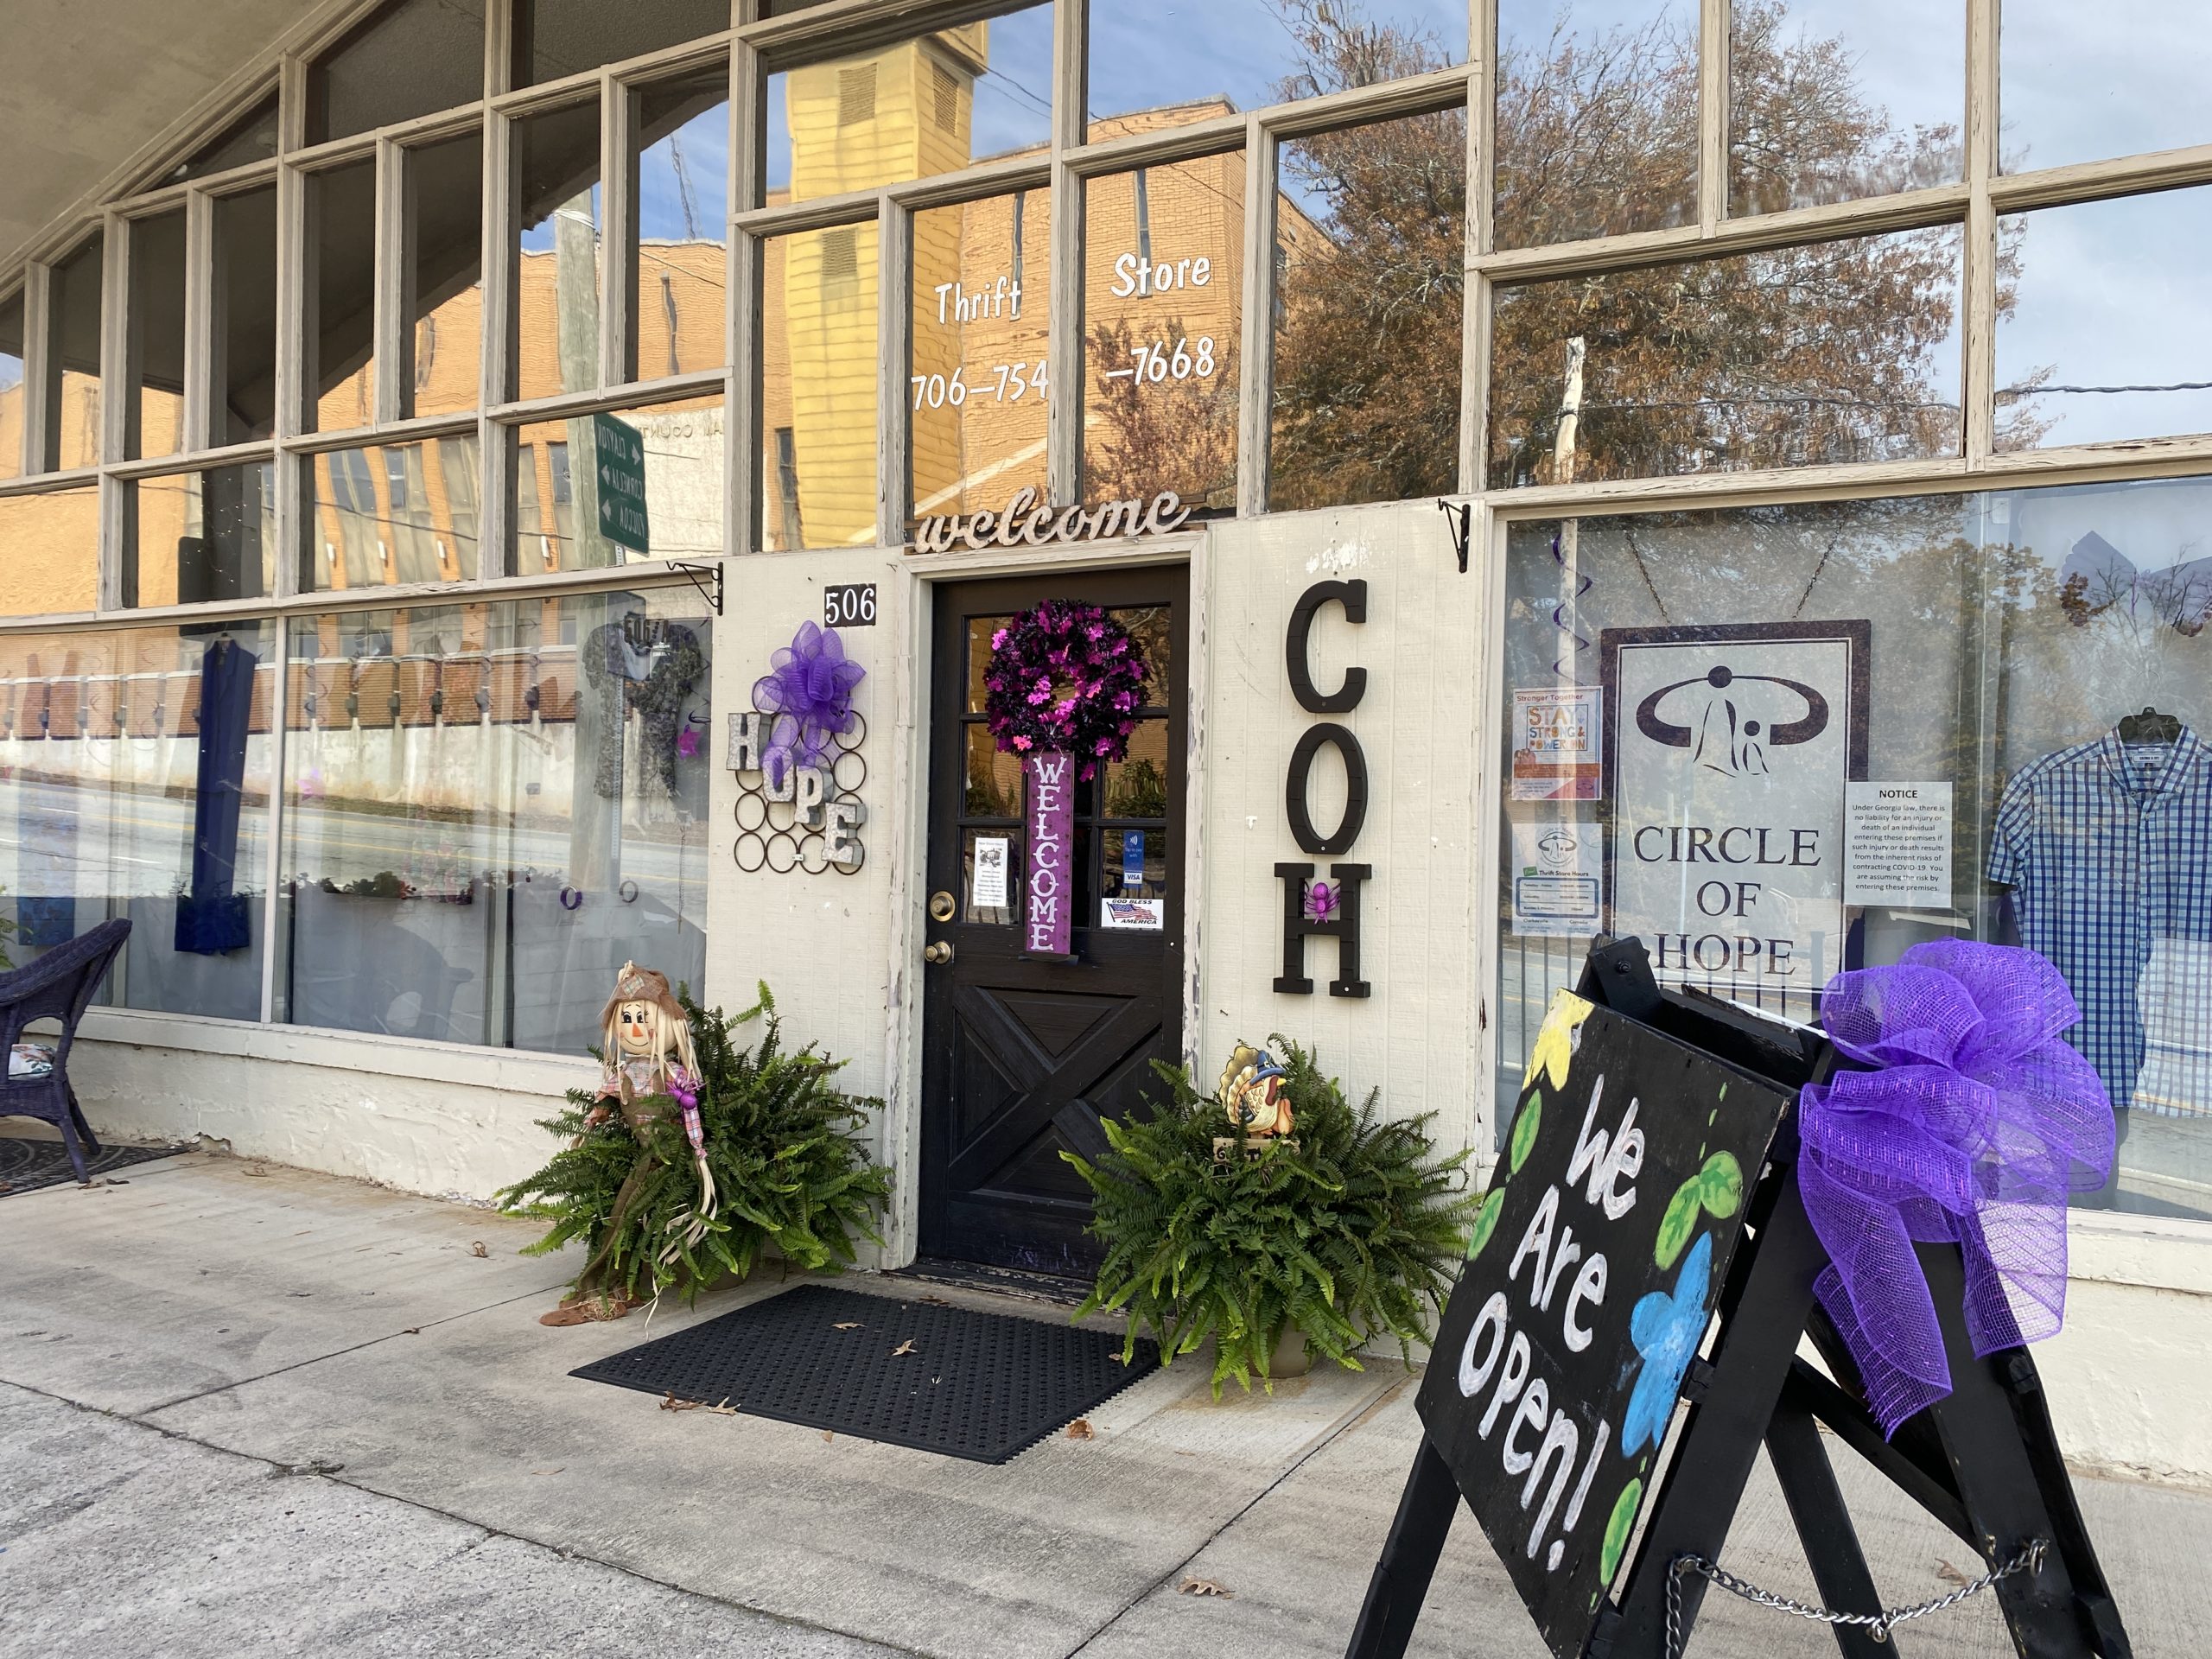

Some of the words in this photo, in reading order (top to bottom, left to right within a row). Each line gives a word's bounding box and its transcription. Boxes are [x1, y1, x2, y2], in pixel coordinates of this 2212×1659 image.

[934, 276, 1022, 325] Thrift
[1110, 252, 1211, 298] Store
[913, 486, 1192, 554] welcome
[825, 588, 876, 623] 506
[1529, 726, 1575, 738] STRONG
[1029, 756, 1068, 951] WELCOME
[1634, 825, 1821, 867] CIRCLE
[1696, 880, 1762, 917] OF
[1654, 933, 1796, 975] HOPE
[1566, 1072, 1646, 1221] We
[1509, 1183, 1609, 1353] Are
